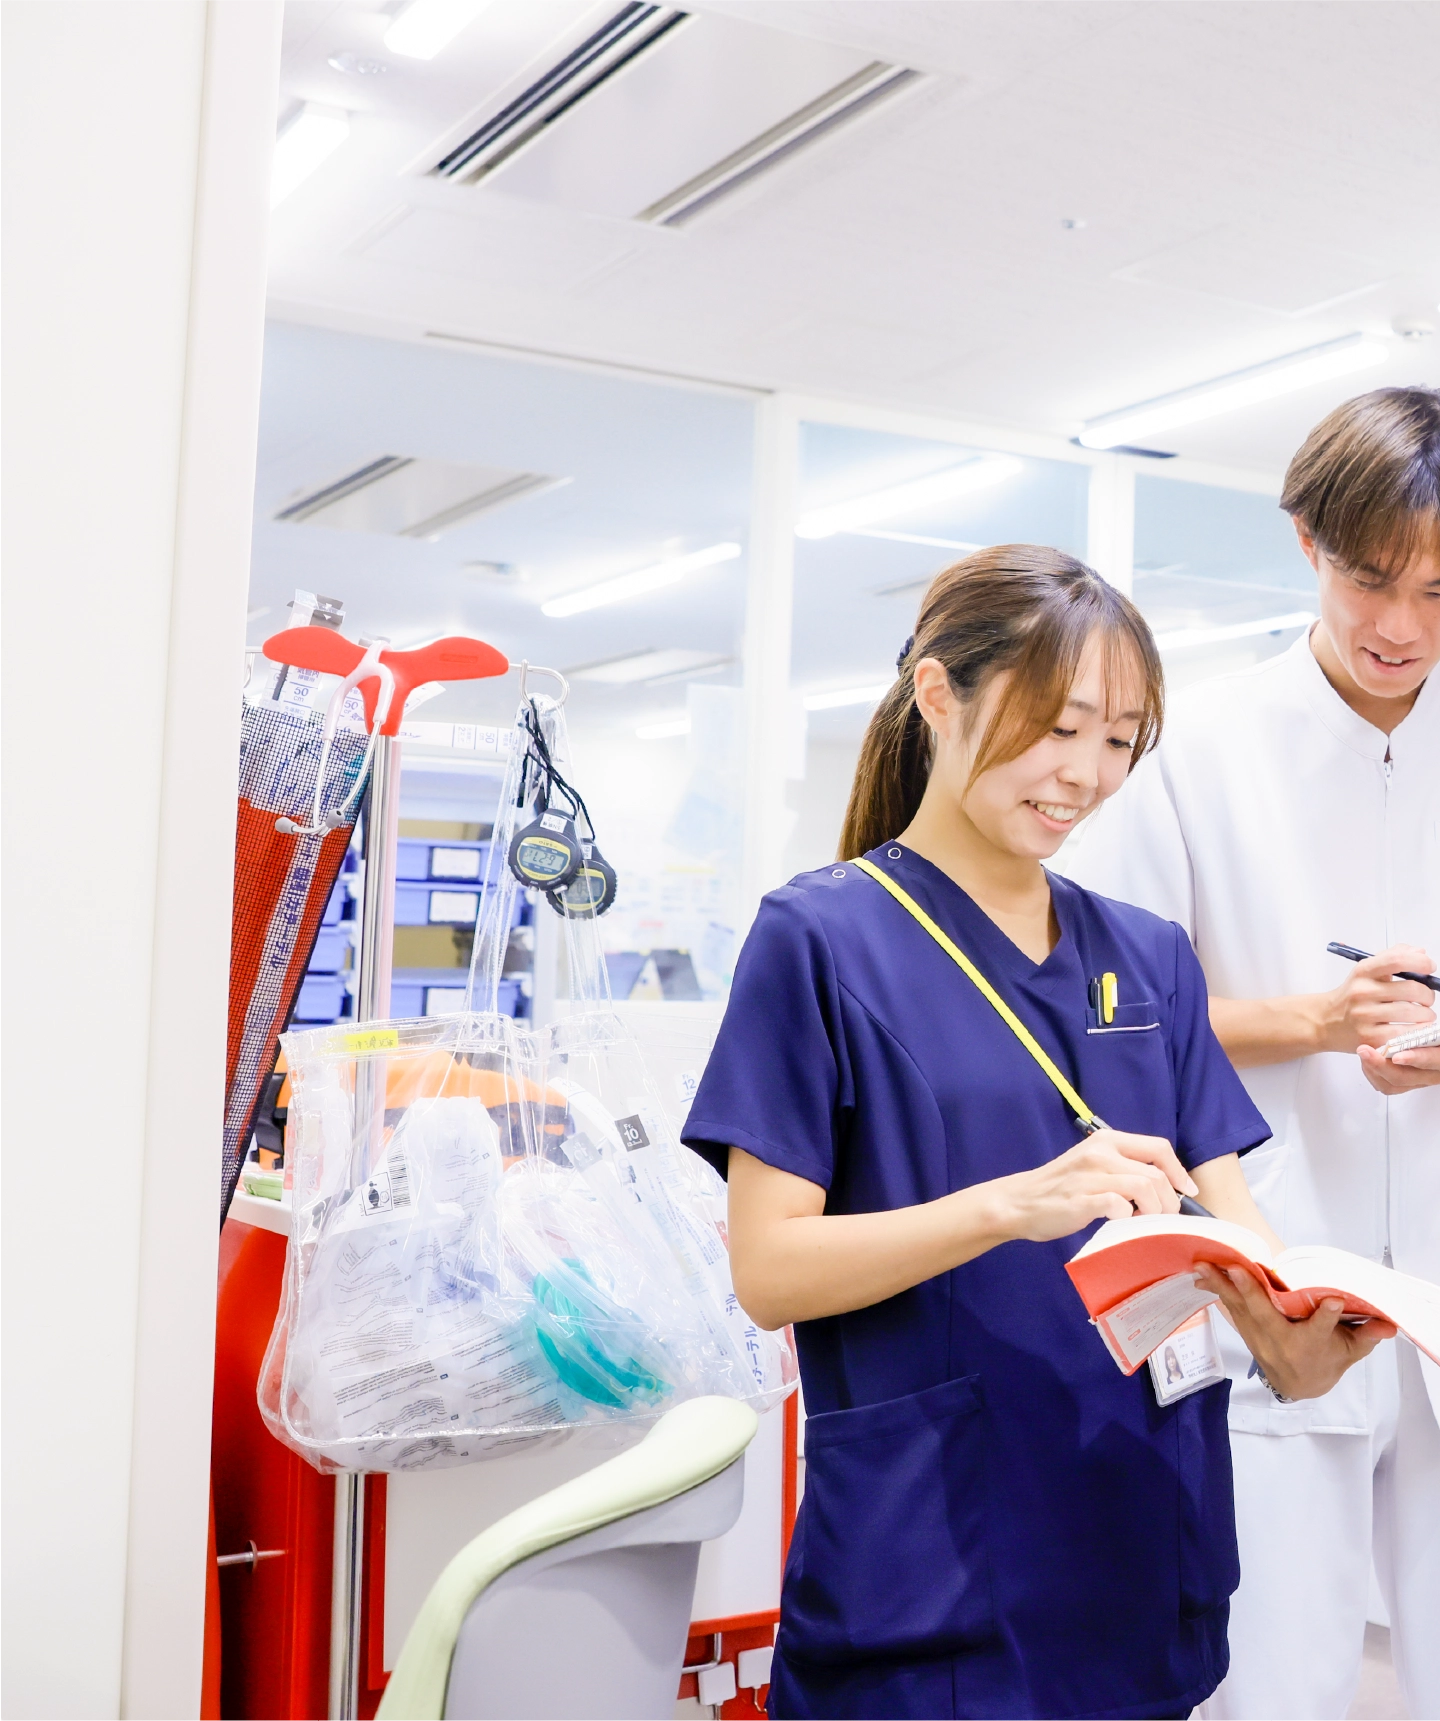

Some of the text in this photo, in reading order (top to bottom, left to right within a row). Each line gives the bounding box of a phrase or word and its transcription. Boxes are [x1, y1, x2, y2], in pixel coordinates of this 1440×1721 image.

[293, 686, 309, 697] 50
[344, 700, 359, 710] 50
[682, 1079, 696, 1090] 12
[623, 1128, 639, 1142] 10
